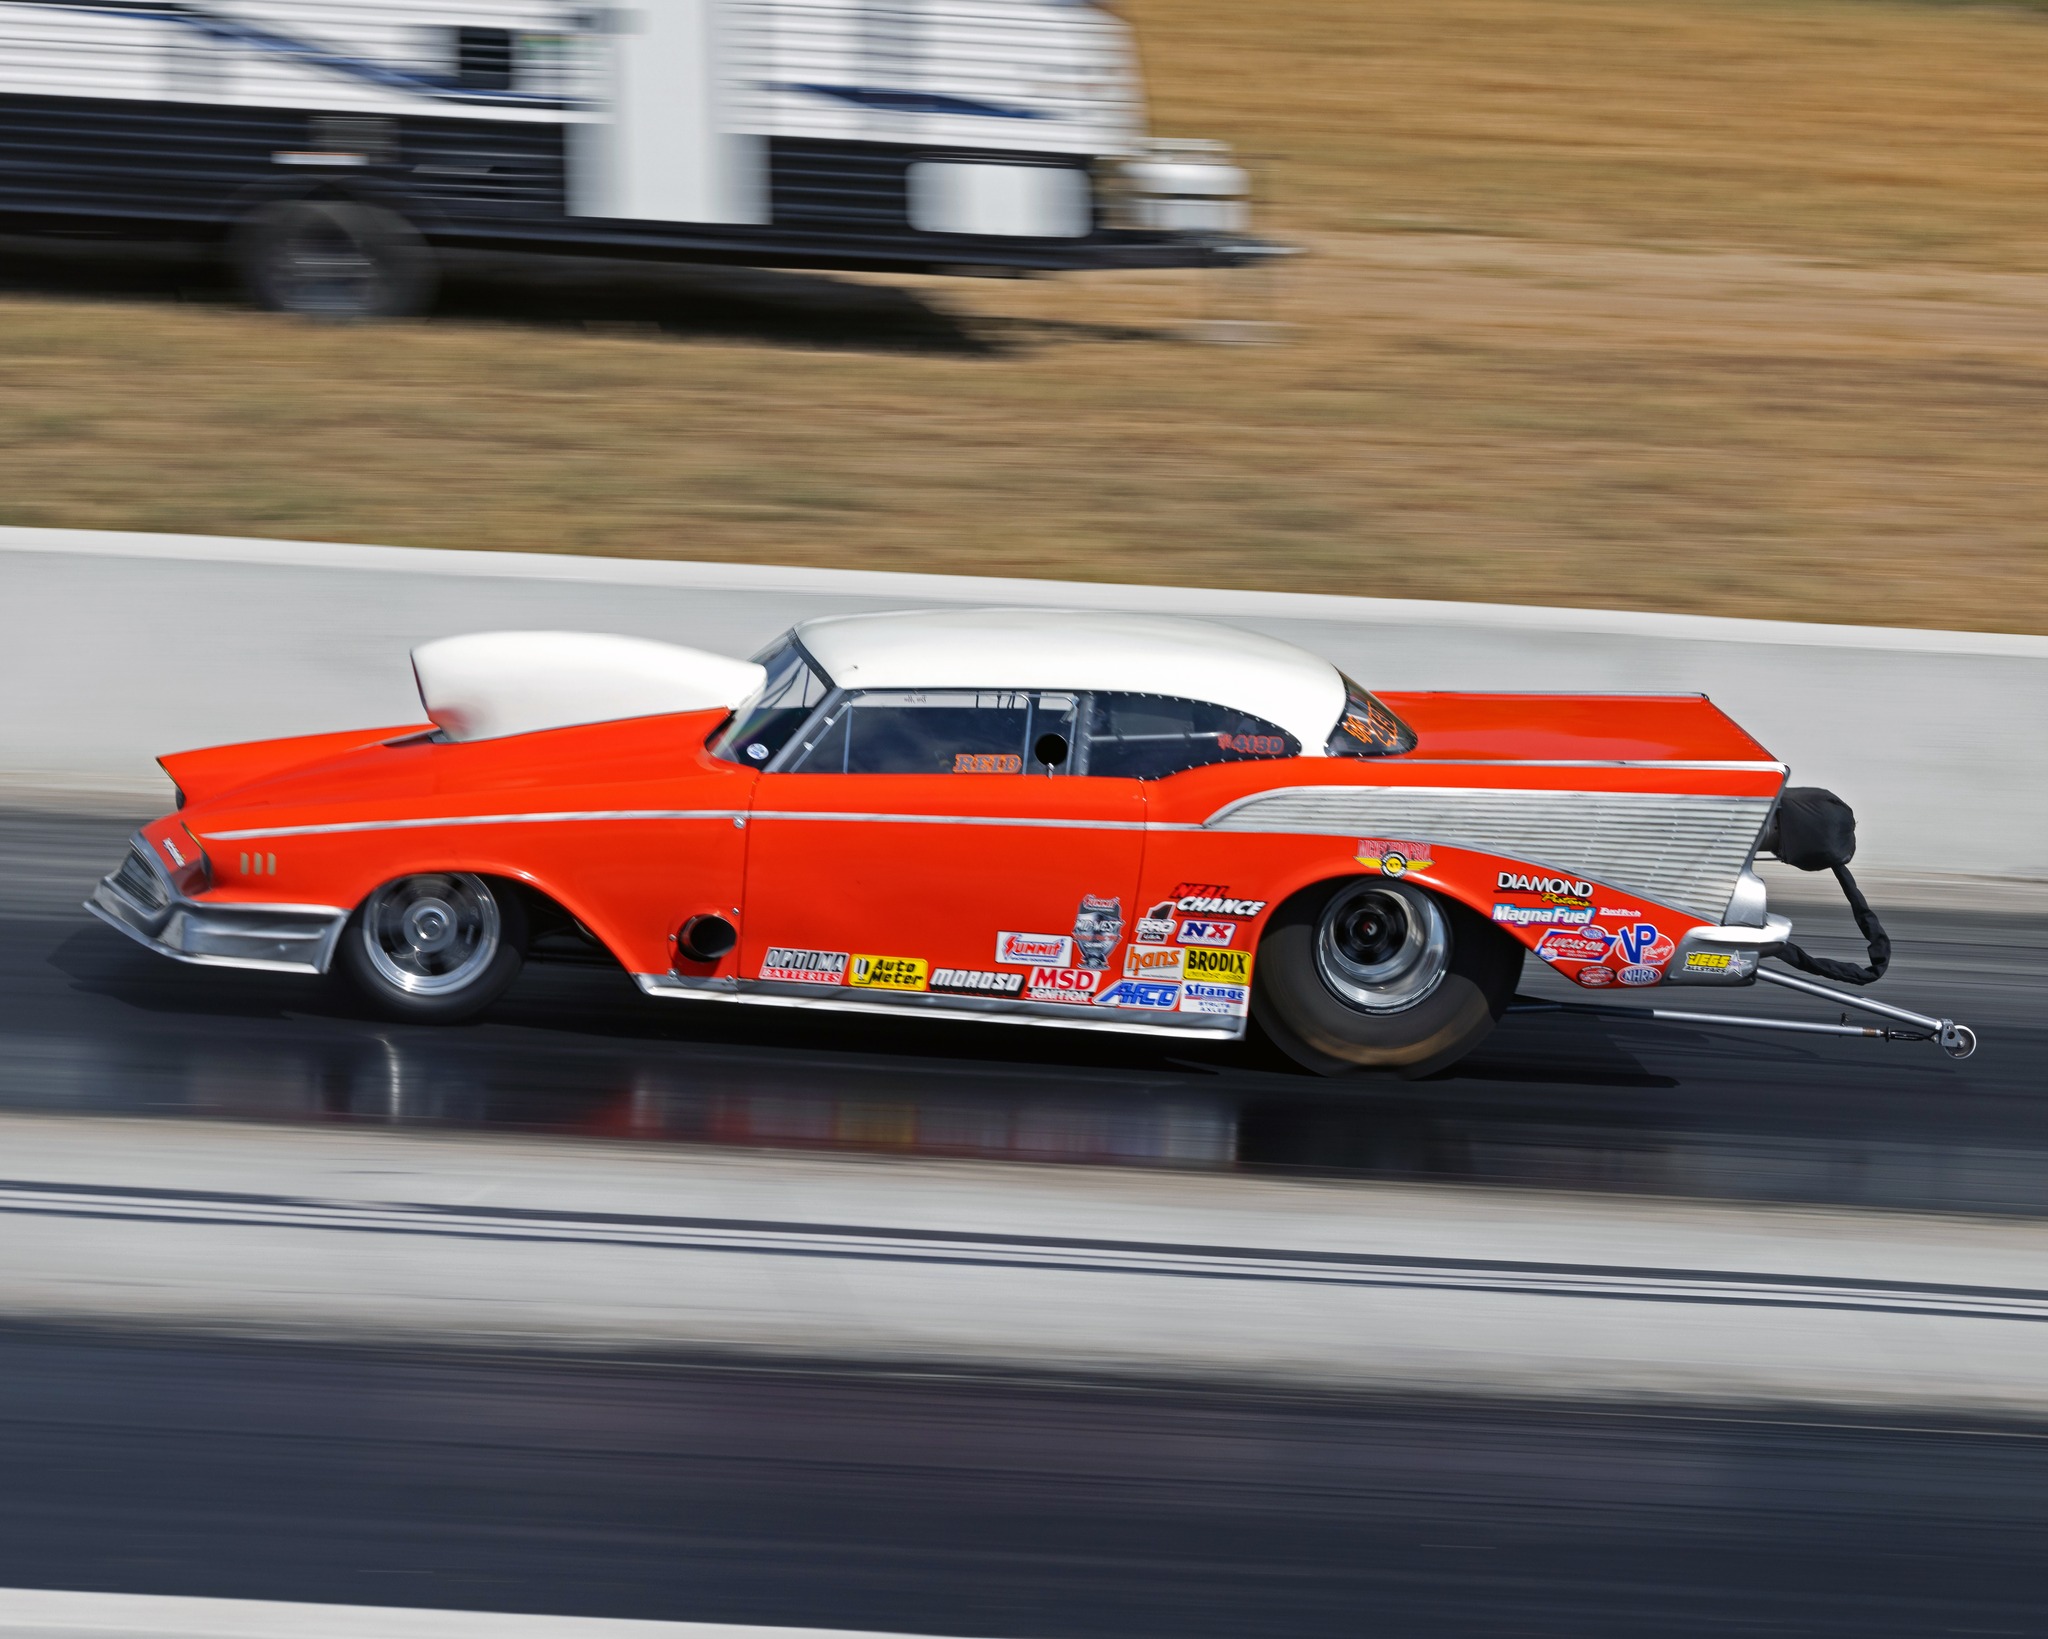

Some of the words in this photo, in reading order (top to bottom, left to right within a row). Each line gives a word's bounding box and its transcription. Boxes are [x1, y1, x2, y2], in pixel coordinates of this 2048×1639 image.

[954, 754, 1022, 773] REID
[1169, 883, 1229, 898] NEAL
[1497, 872, 1594, 898] DIAMOND
[1177, 896, 1266, 916] CHANCE
[1493, 904, 1593, 925] MagnaFuel
[1137, 918, 1176, 934] PRO
[1184, 922, 1231, 939] NX
[1545, 937, 1586, 950] LUCAS
[1585, 941, 1605, 952] OIL
[1620, 924, 1658, 964] VP
[767, 950, 844, 972] OPTIMA
[875, 959, 915, 972] Auto
[1127, 946, 1180, 976] hans
[1188, 951, 1246, 974] BRODIX
[1687, 953, 1731, 968] JEGS
[762, 968, 841, 983] BATTERIES
[871, 971, 923, 984] Meter
[930, 968, 1024, 991] MOROSO
[1034, 968, 1094, 990] MSD
[1624, 969, 1656, 982] NHRA
[1031, 987, 1090, 1002] IGNITION
[1185, 984, 1244, 999] Strange
